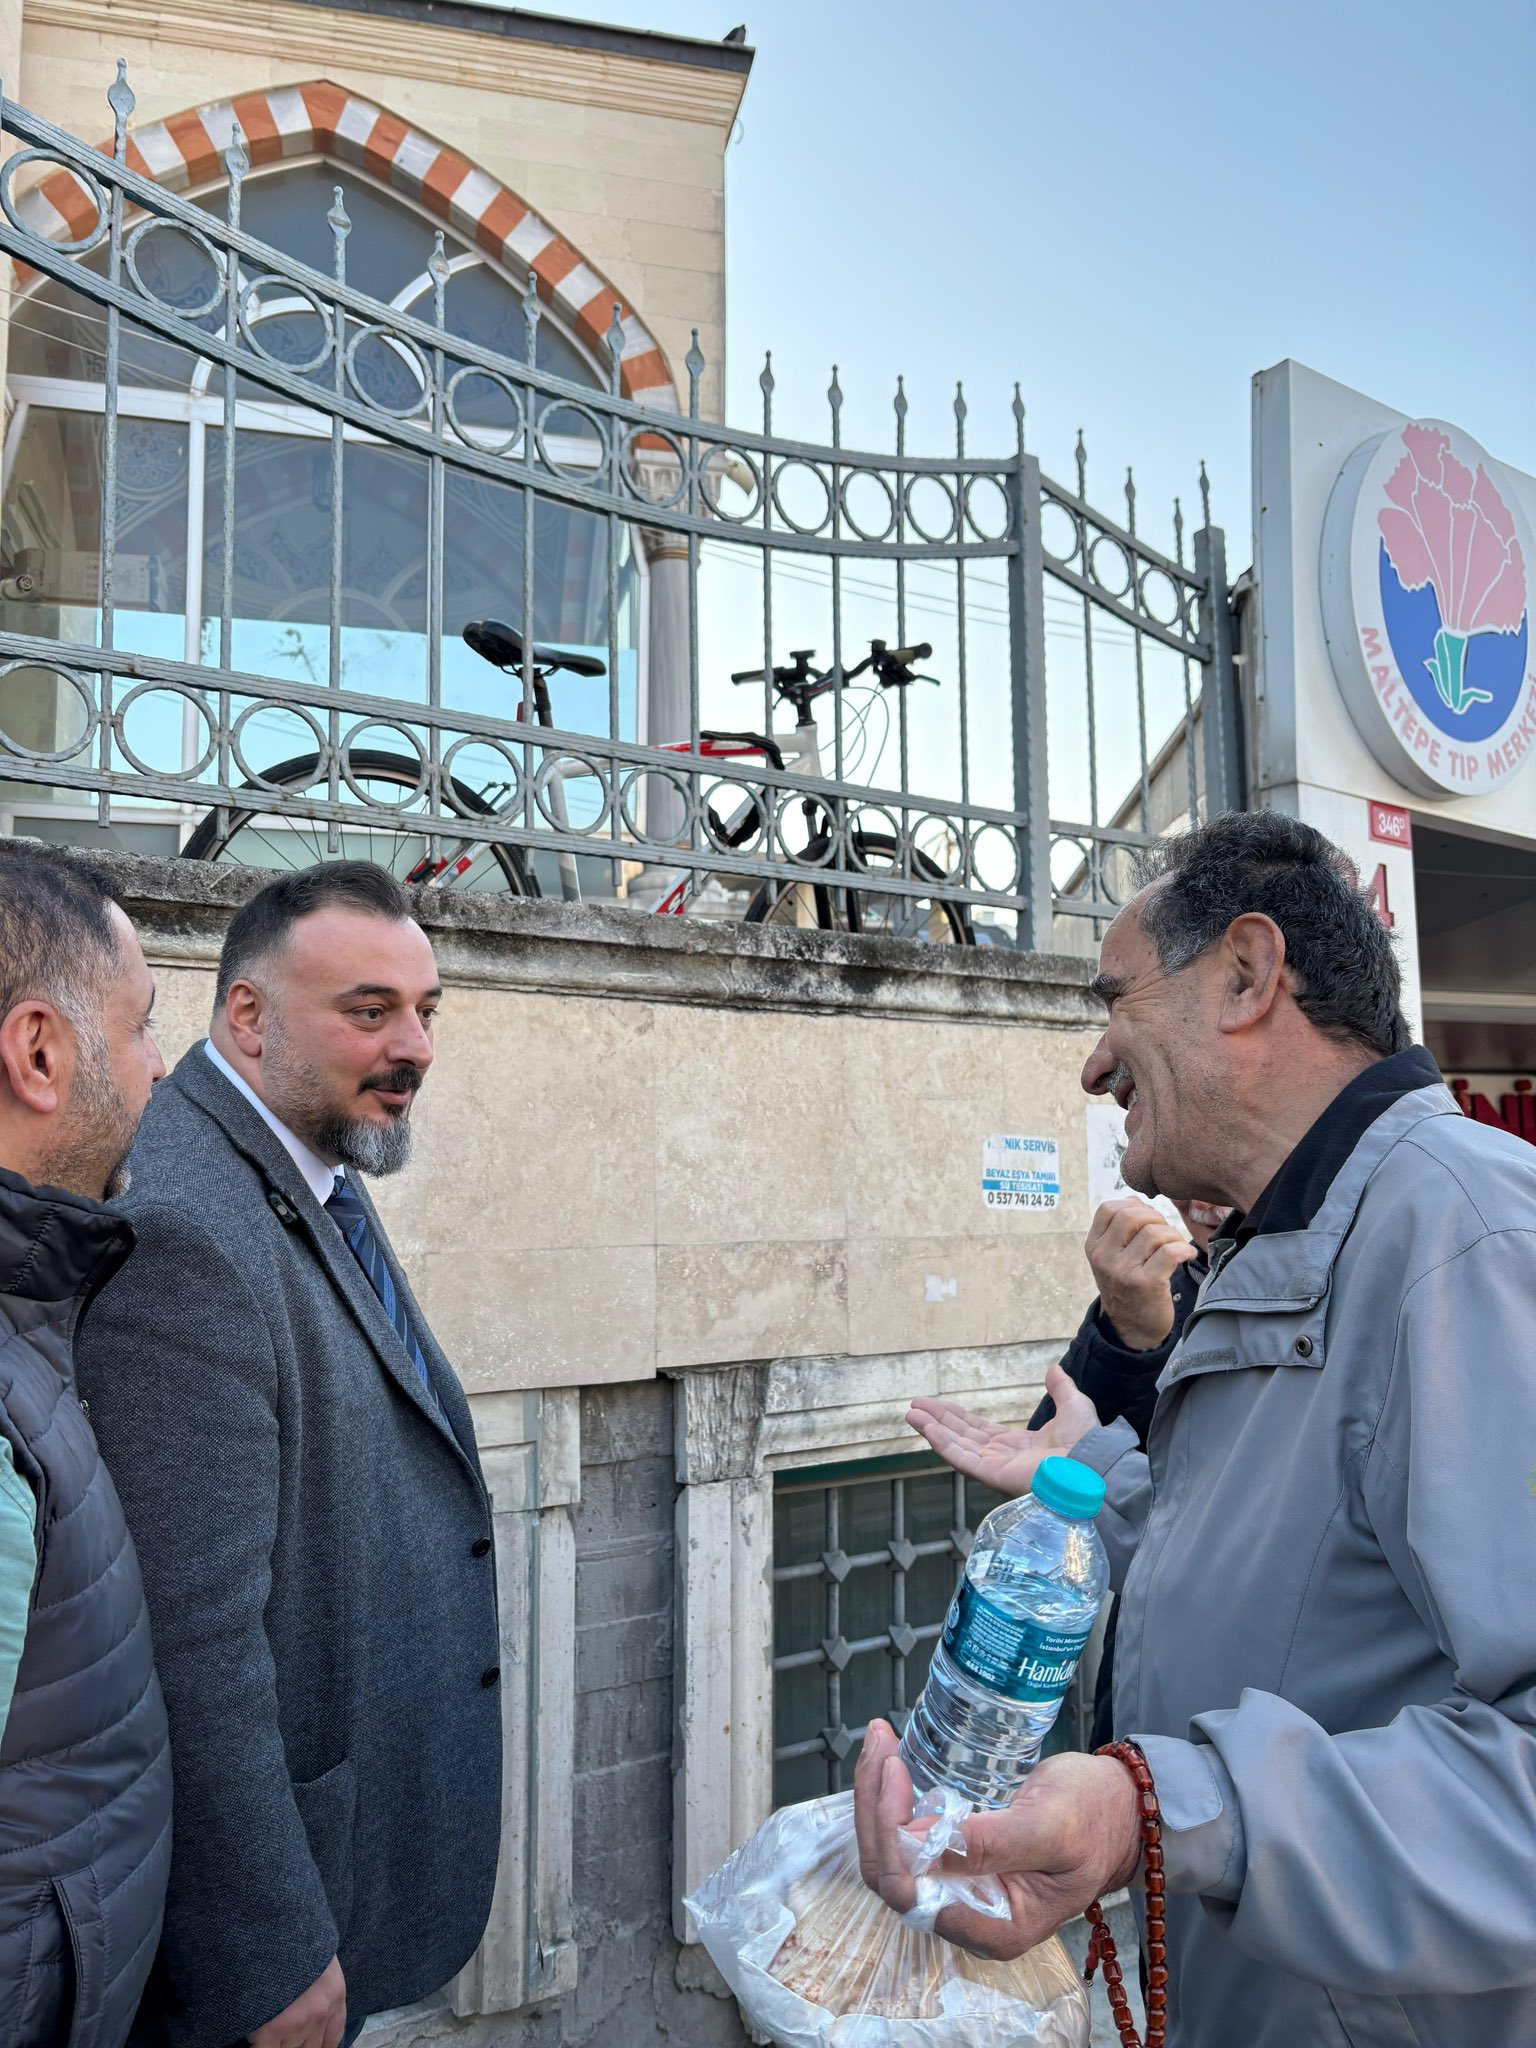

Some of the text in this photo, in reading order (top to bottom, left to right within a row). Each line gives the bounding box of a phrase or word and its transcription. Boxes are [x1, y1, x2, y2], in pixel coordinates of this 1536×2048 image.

[1360, 627, 1440, 768] MALTEPE
[1448, 750, 1478, 781] TIP
[986, 1168, 1010, 1177] BEYAZ
[1011, 1170, 1030, 1180] EŞYA
[988, 1191, 1055, 1206] 0 537 741 24 26
